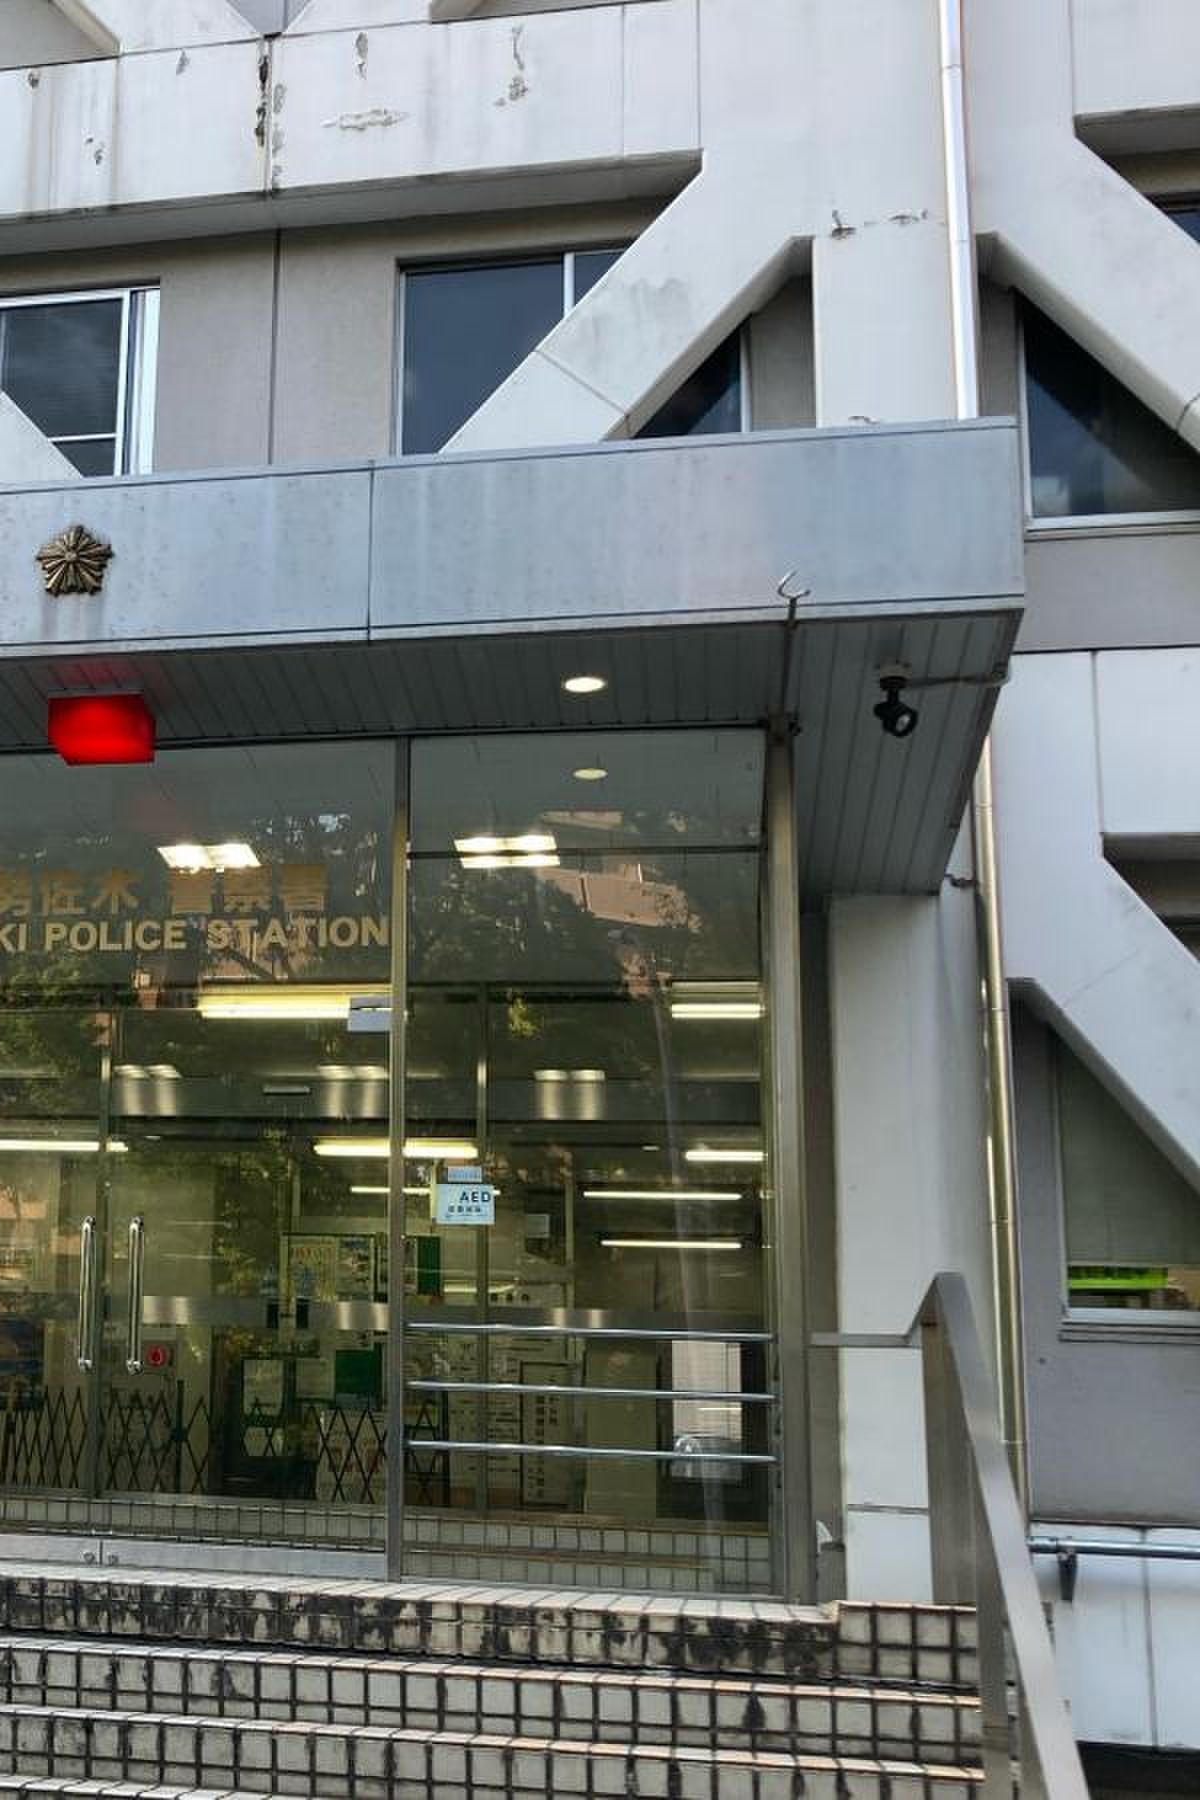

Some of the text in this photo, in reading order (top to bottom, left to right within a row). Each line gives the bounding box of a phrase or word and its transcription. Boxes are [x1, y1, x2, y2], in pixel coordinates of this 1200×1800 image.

[45, 919, 187, 952] POLICE
[206, 916, 390, 951] STATION
[460, 1191, 491, 1202] AED
